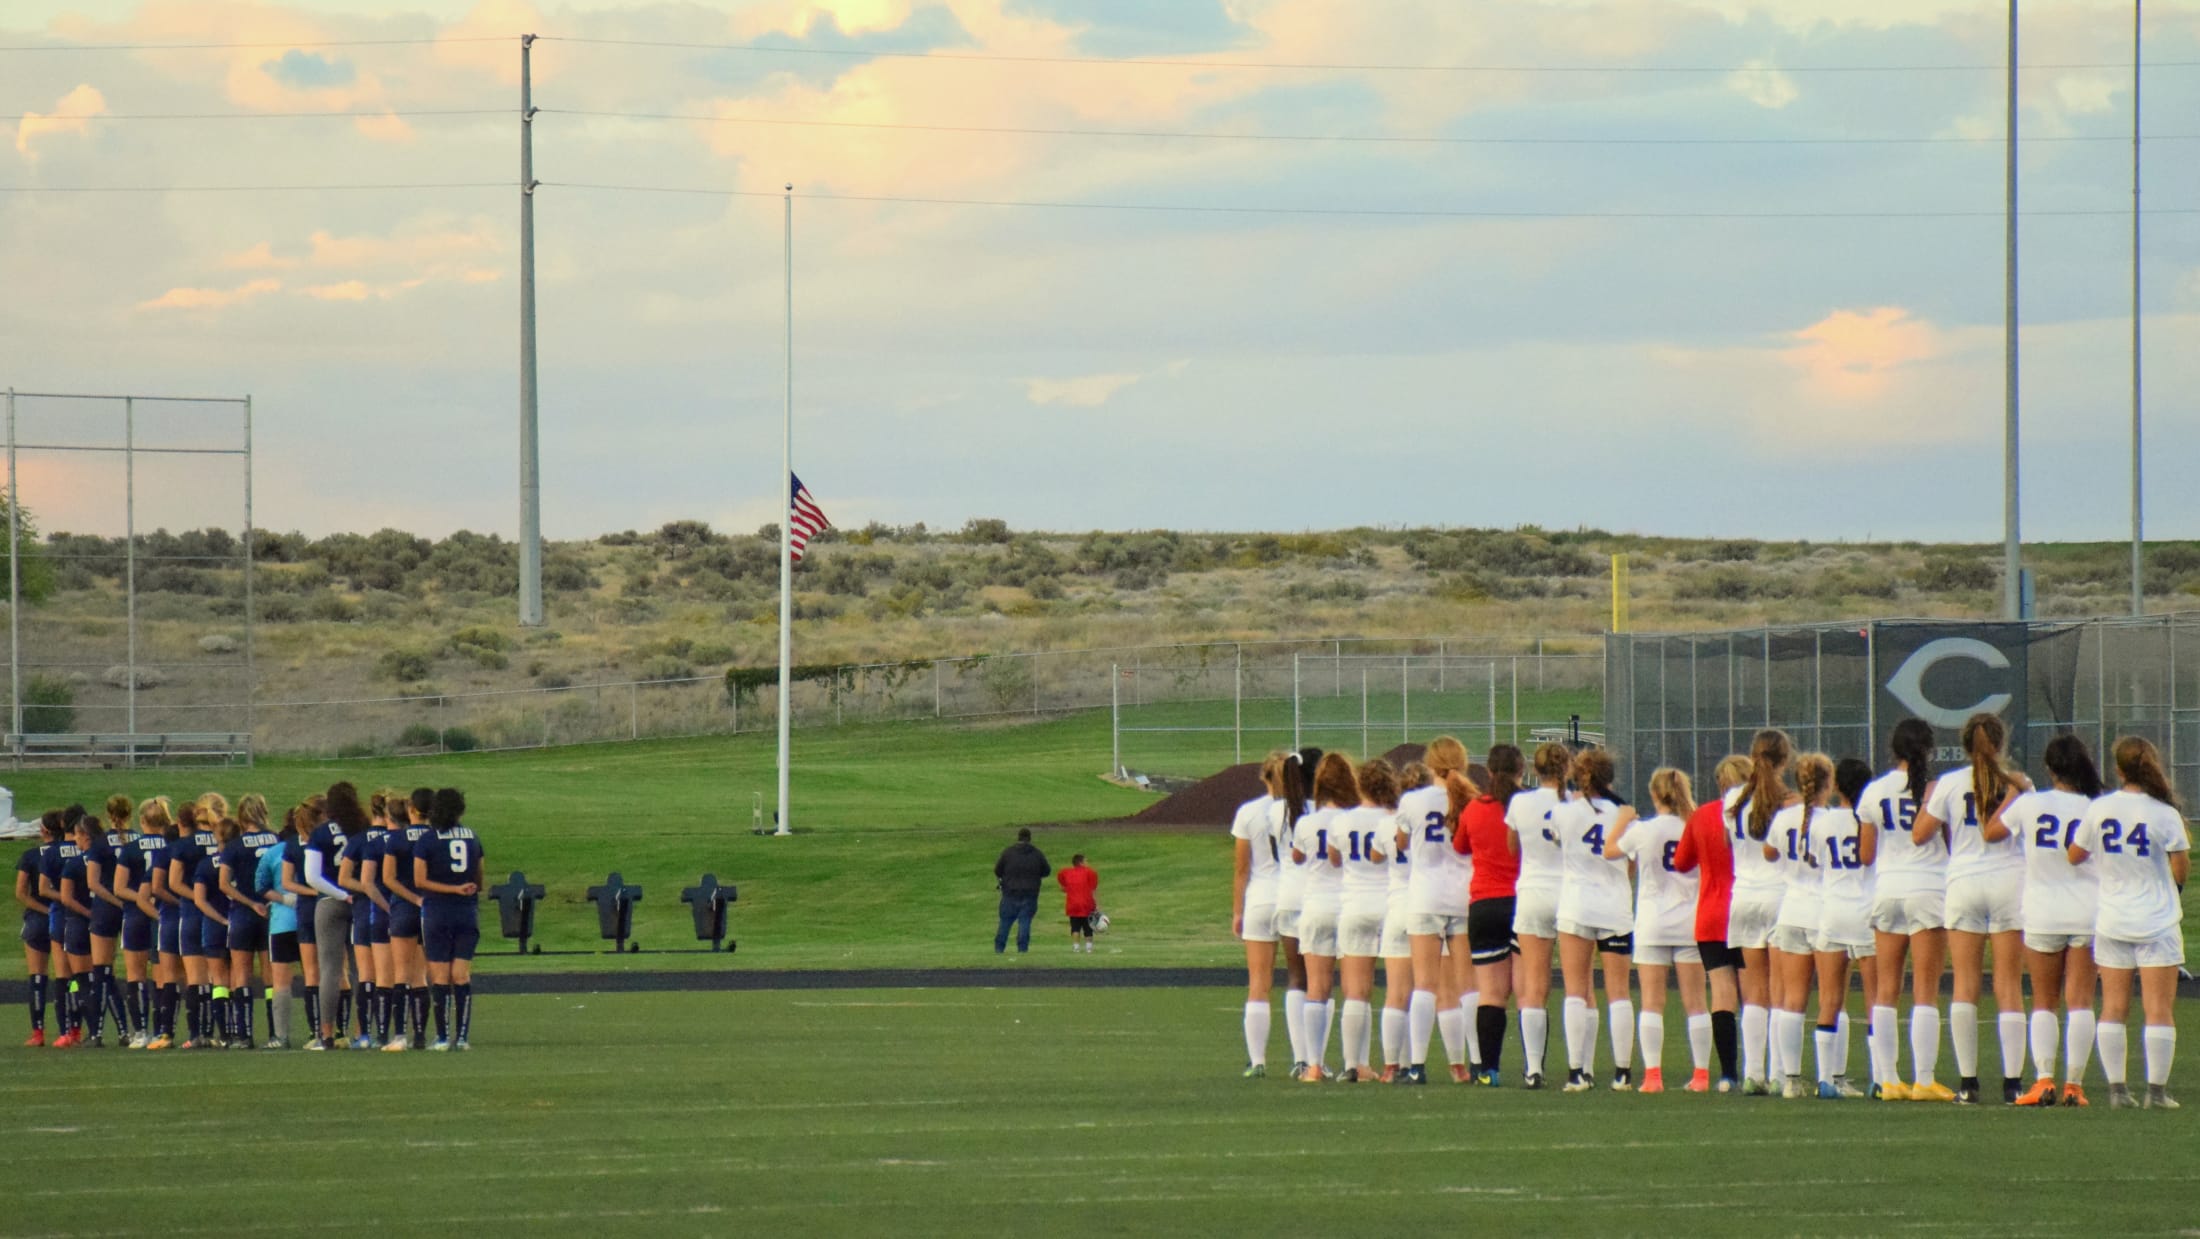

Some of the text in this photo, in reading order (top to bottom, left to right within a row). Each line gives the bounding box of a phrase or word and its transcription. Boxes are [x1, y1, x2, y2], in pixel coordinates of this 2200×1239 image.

[1886, 637, 2012, 729] C
[1880, 799, 1917, 831] 15
[1582, 824, 1604, 855] 4
[1826, 836, 1861, 869] 13
[2101, 819, 2150, 856] 24
[449, 840, 467, 872] 9
